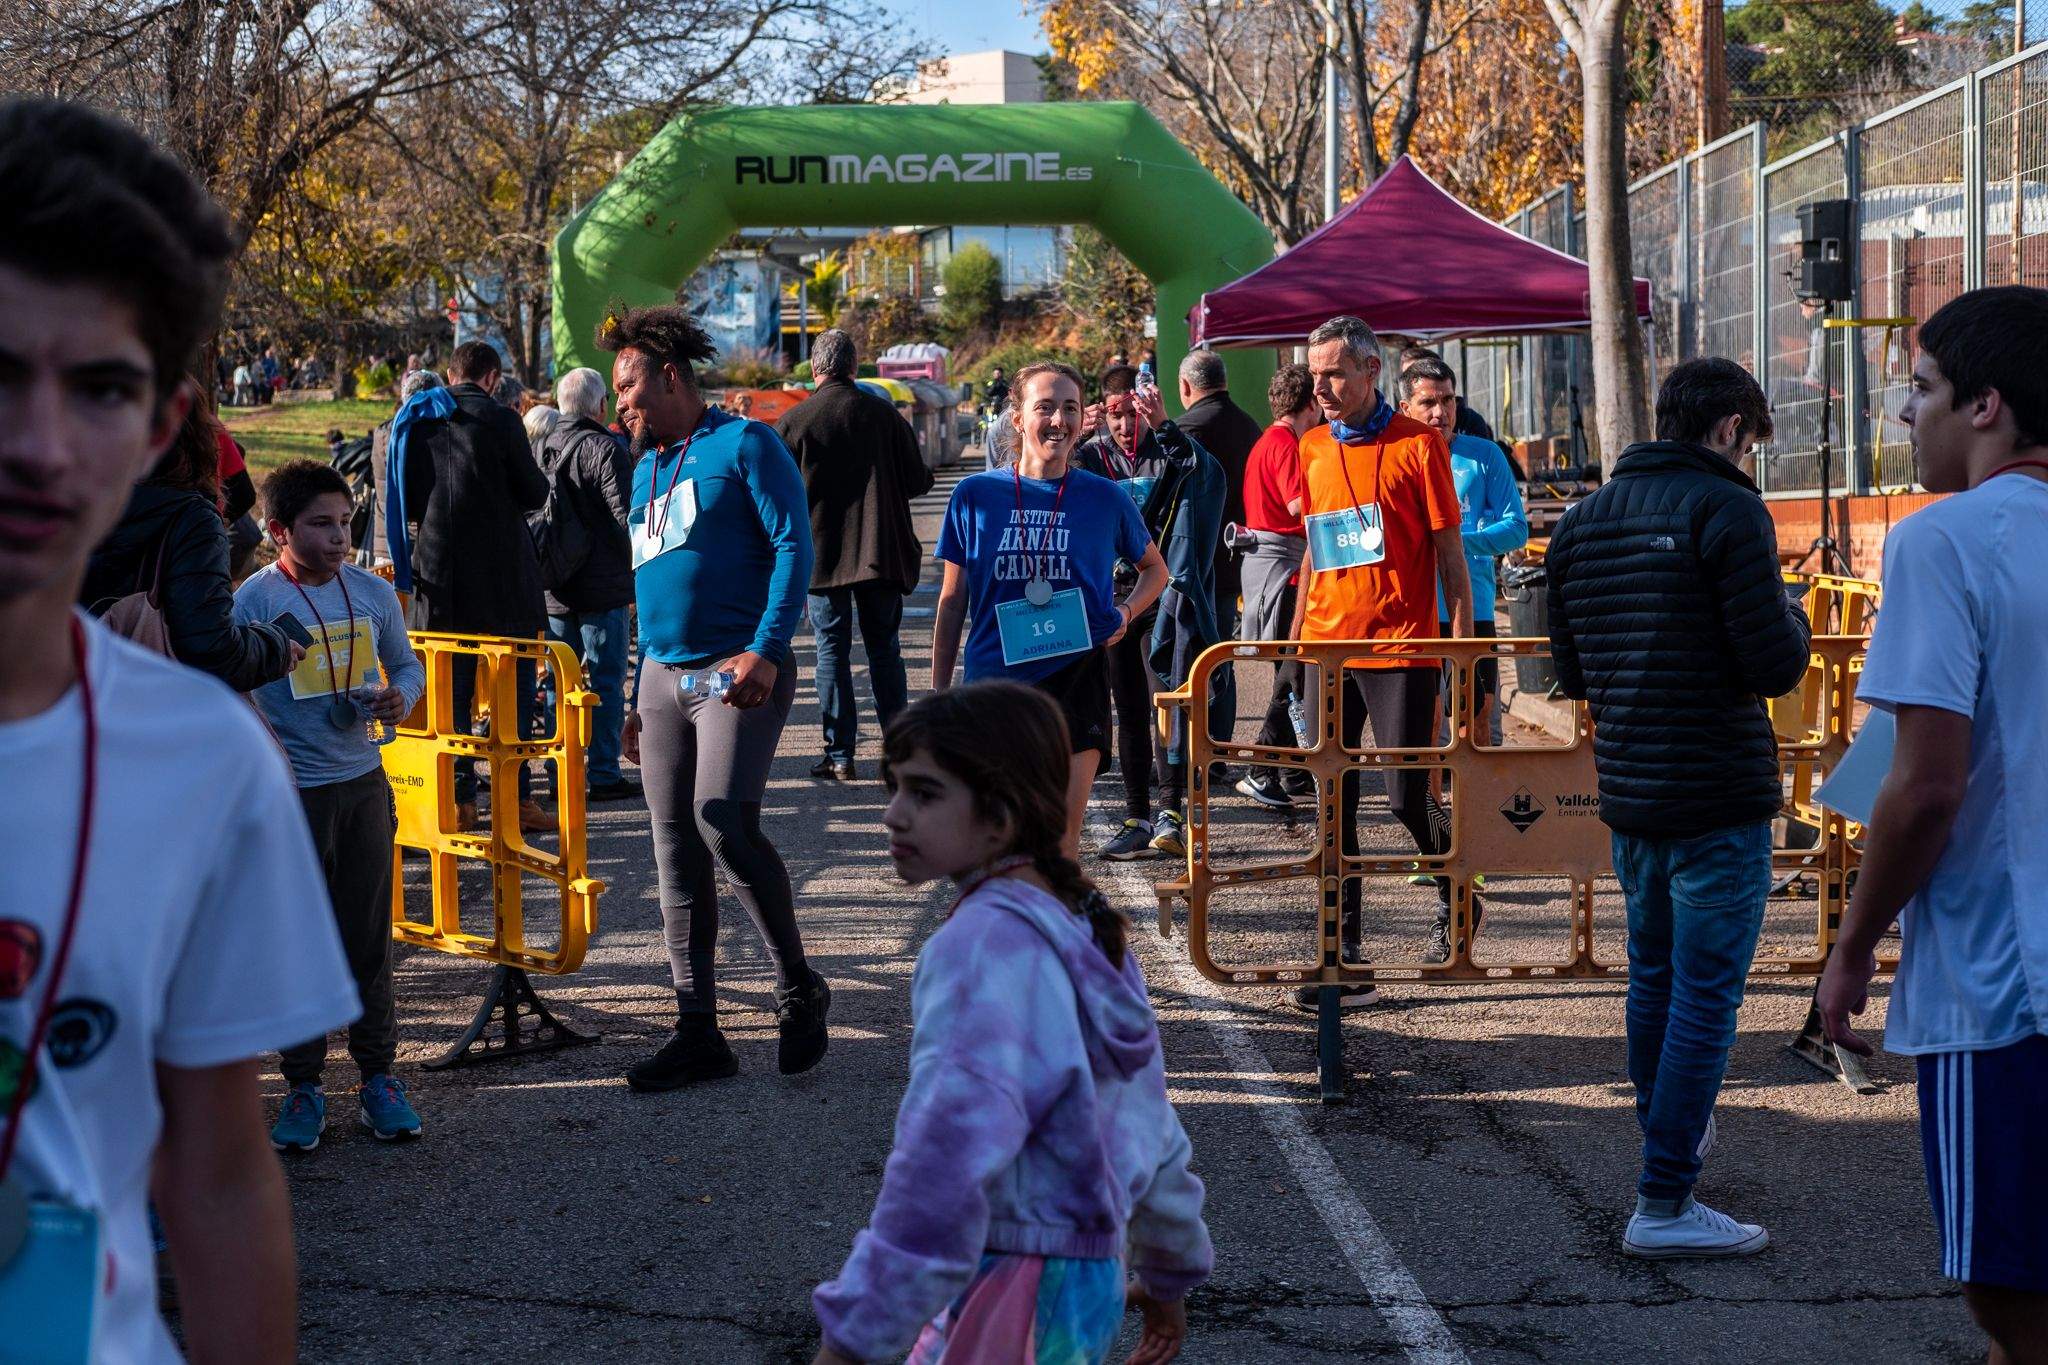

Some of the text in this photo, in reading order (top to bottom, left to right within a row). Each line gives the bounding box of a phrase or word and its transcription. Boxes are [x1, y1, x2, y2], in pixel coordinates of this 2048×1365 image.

[1009, 510, 1066, 525] INSTITUT
[997, 527, 1071, 552] ARNAU
[994, 555, 1071, 581] CADELL
[1032, 619, 1056, 637] 16
[1023, 641, 1073, 656] ADRIANA
[1558, 808, 1587, 817] Entitat
